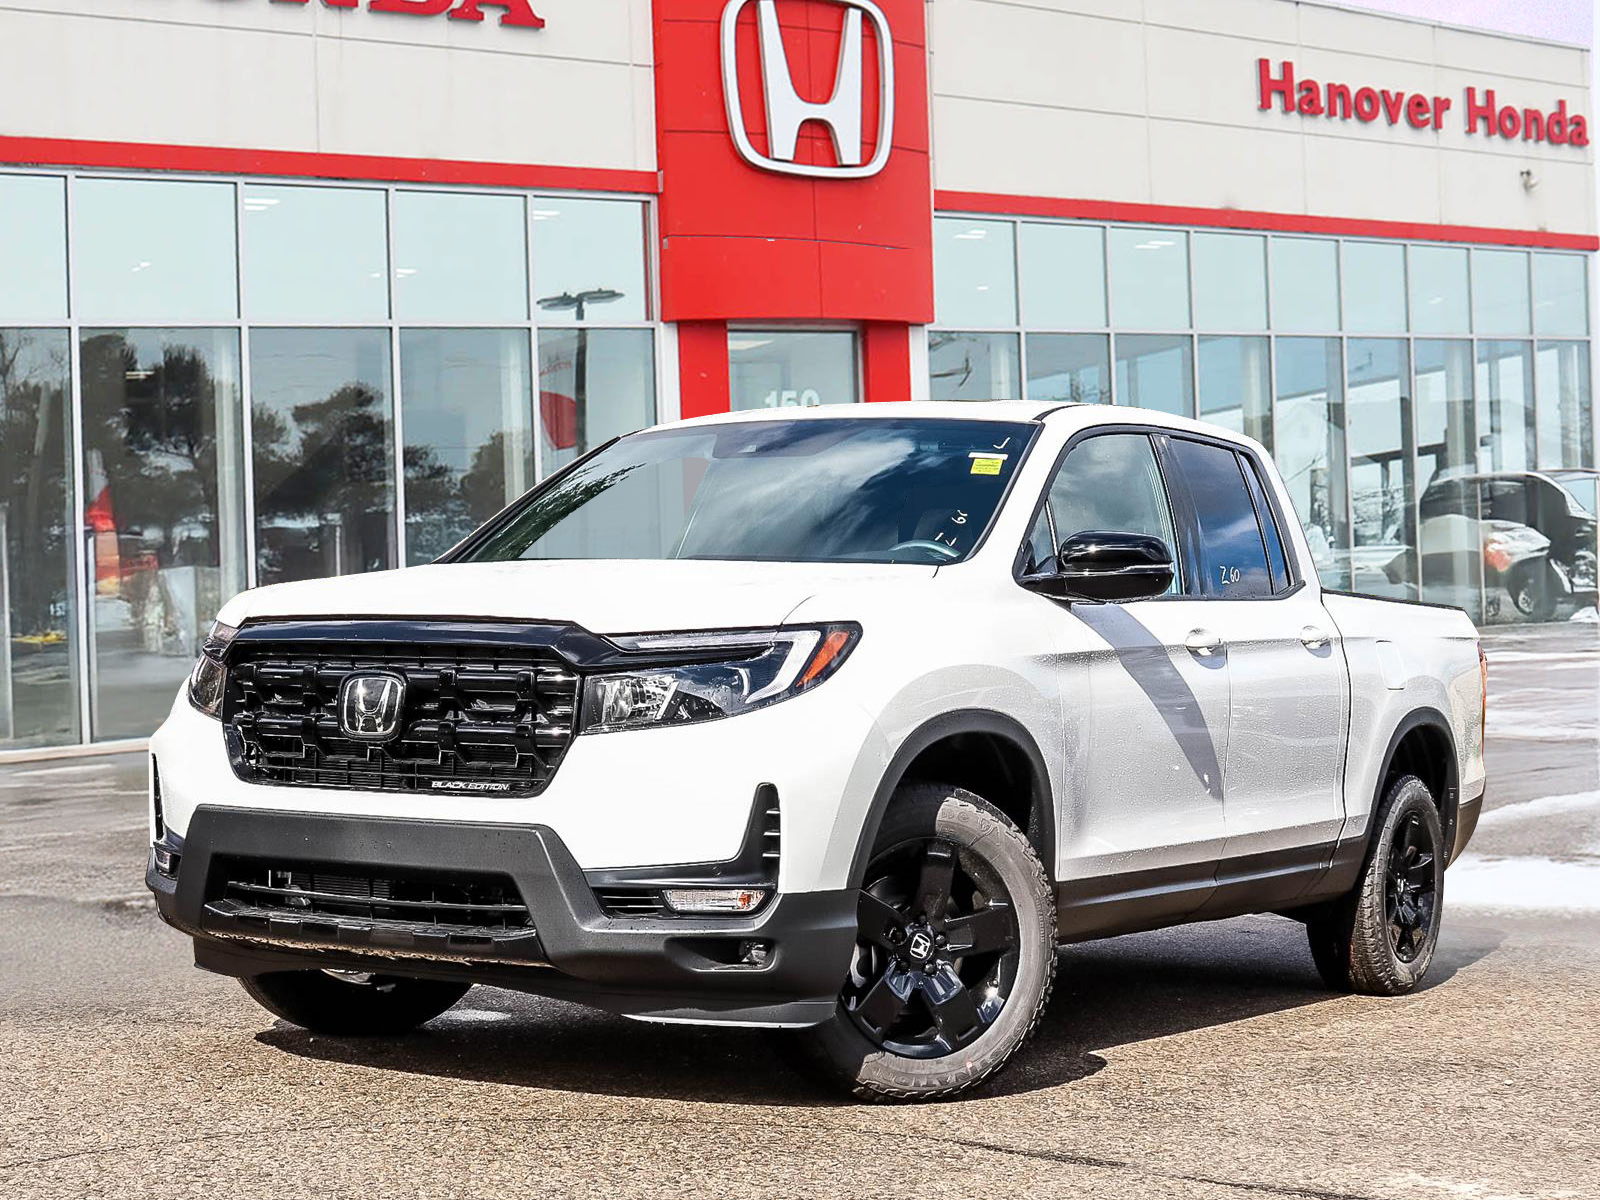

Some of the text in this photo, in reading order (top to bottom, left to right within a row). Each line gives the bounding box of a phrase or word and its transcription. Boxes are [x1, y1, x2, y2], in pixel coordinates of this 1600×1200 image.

[1257, 57, 1590, 148] Hanover Honda
[764, 388, 820, 408] 150
[431, 780, 509, 791] BLACK EDITION
